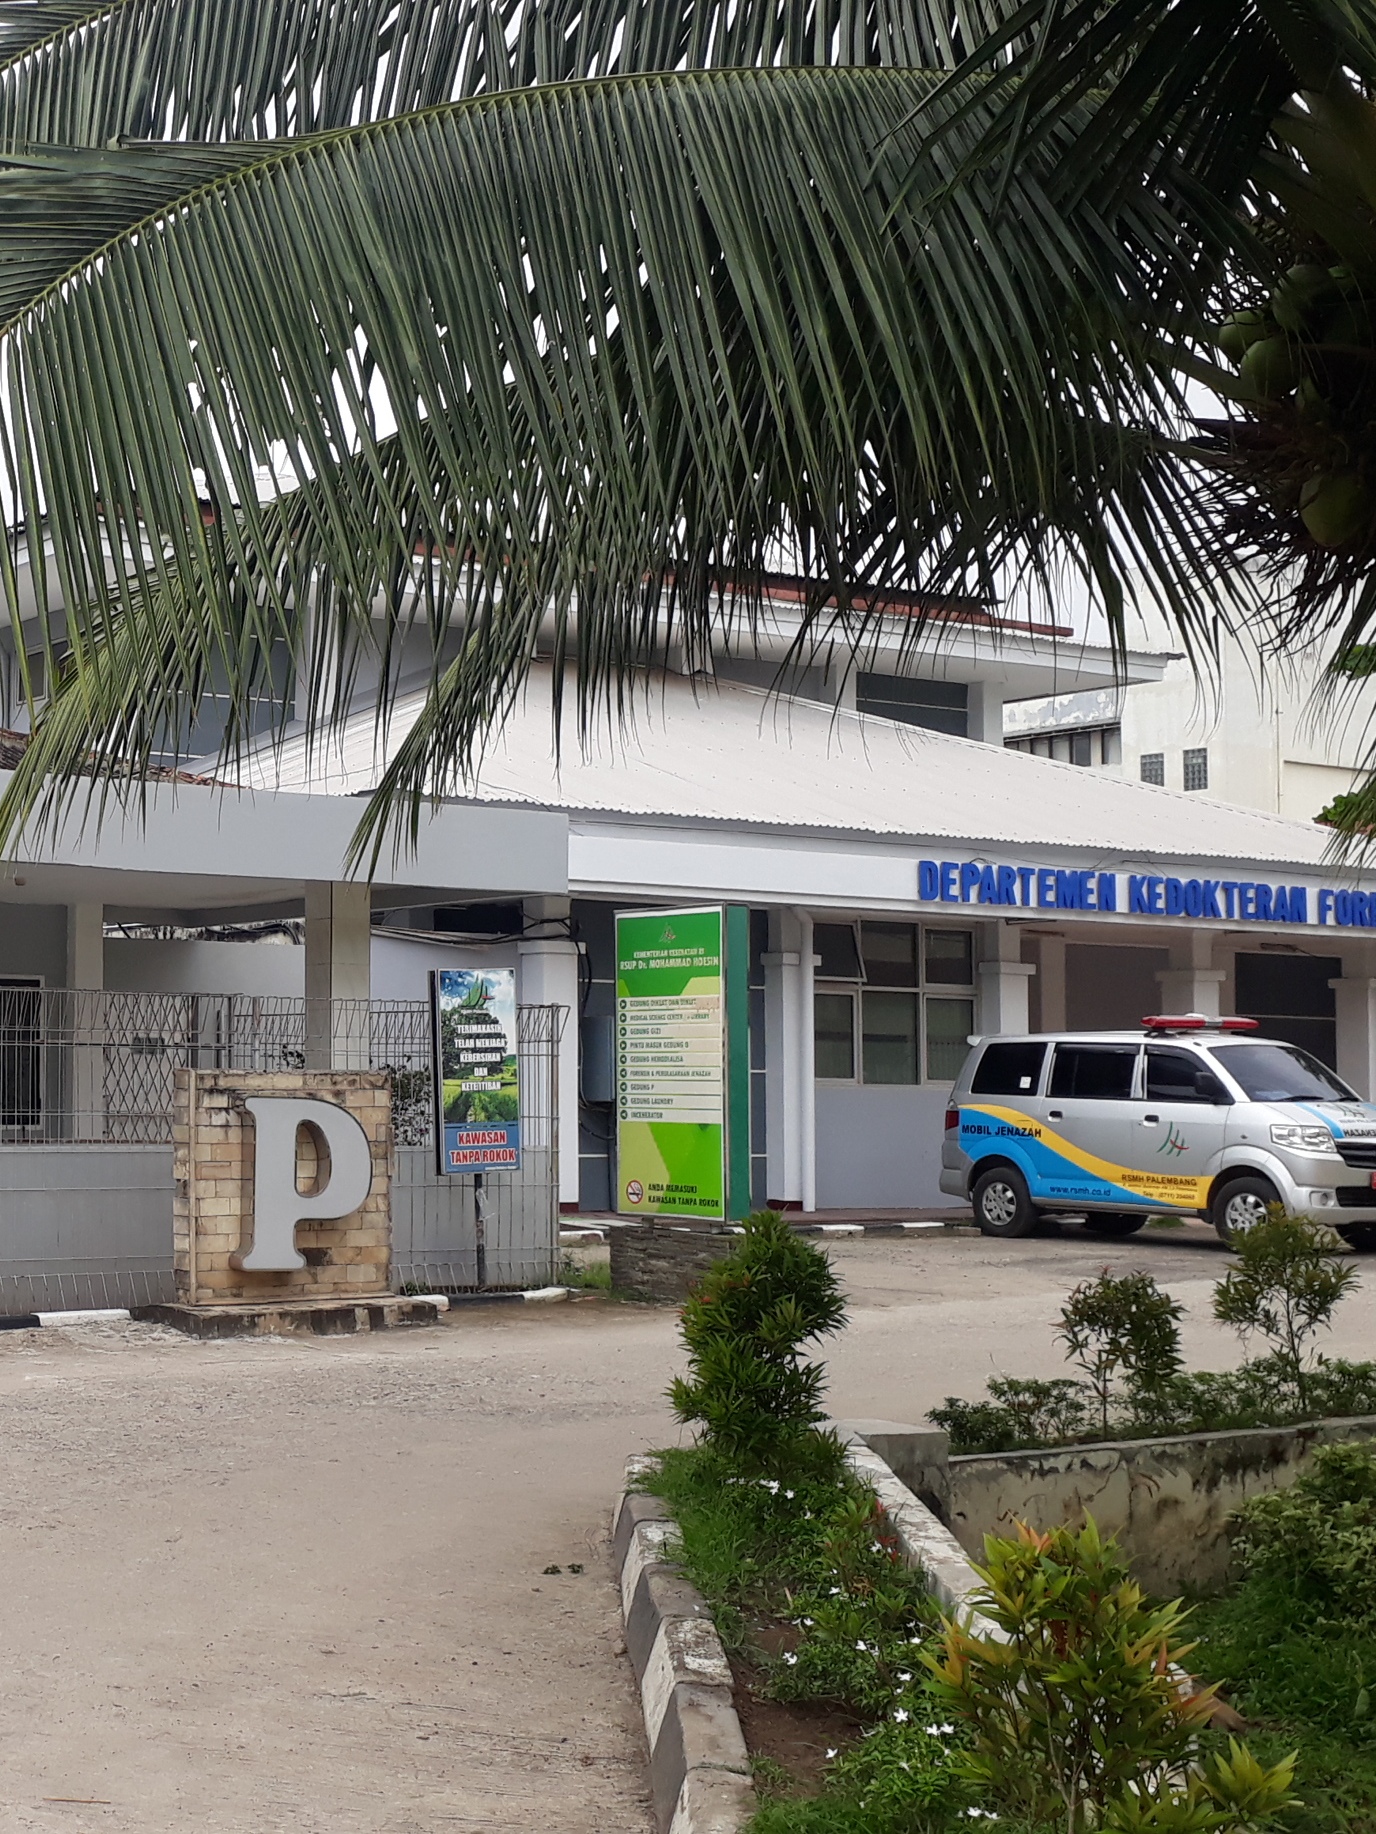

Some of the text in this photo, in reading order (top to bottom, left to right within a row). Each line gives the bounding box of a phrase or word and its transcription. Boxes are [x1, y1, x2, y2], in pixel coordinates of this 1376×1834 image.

[918, 860, 1116, 912] DEPARTEMEN
[1128, 874, 1307, 923] KEDOKTERAN
[619, 956, 719, 970] RSUP Dr. MOHAMMAD HOESIN
[629, 1027, 650, 1035] GEDUNG
[454, 1038, 505, 1048] TELAH MENJAGA
[629, 1041, 645, 1049] PINTU
[460, 1052, 501, 1063] KEBERSIHAN
[629, 1055, 650, 1063] GEDUNG
[474, 1067, 488, 1077] DAN
[630, 1083, 650, 1091] GEDUNG
[630, 1097, 650, 1105] GEDUNG
[961, 1124, 1042, 1138] MOBIL JENAZAH
[457, 1130, 508, 1146] KAWASAN
[450, 1148, 516, 1165] TANPA ROKOK
[232, 1096, 373, 1272] P
[1121, 1174, 1198, 1187] RSMH PALEMBANG
[647, 1183, 698, 1194] ANDA MEMASUKI
[1049, 1185, 1112, 1197] www.rsmh.co.id
[647, 1195, 719, 1207] KAWASAN TANPA ROKOK
